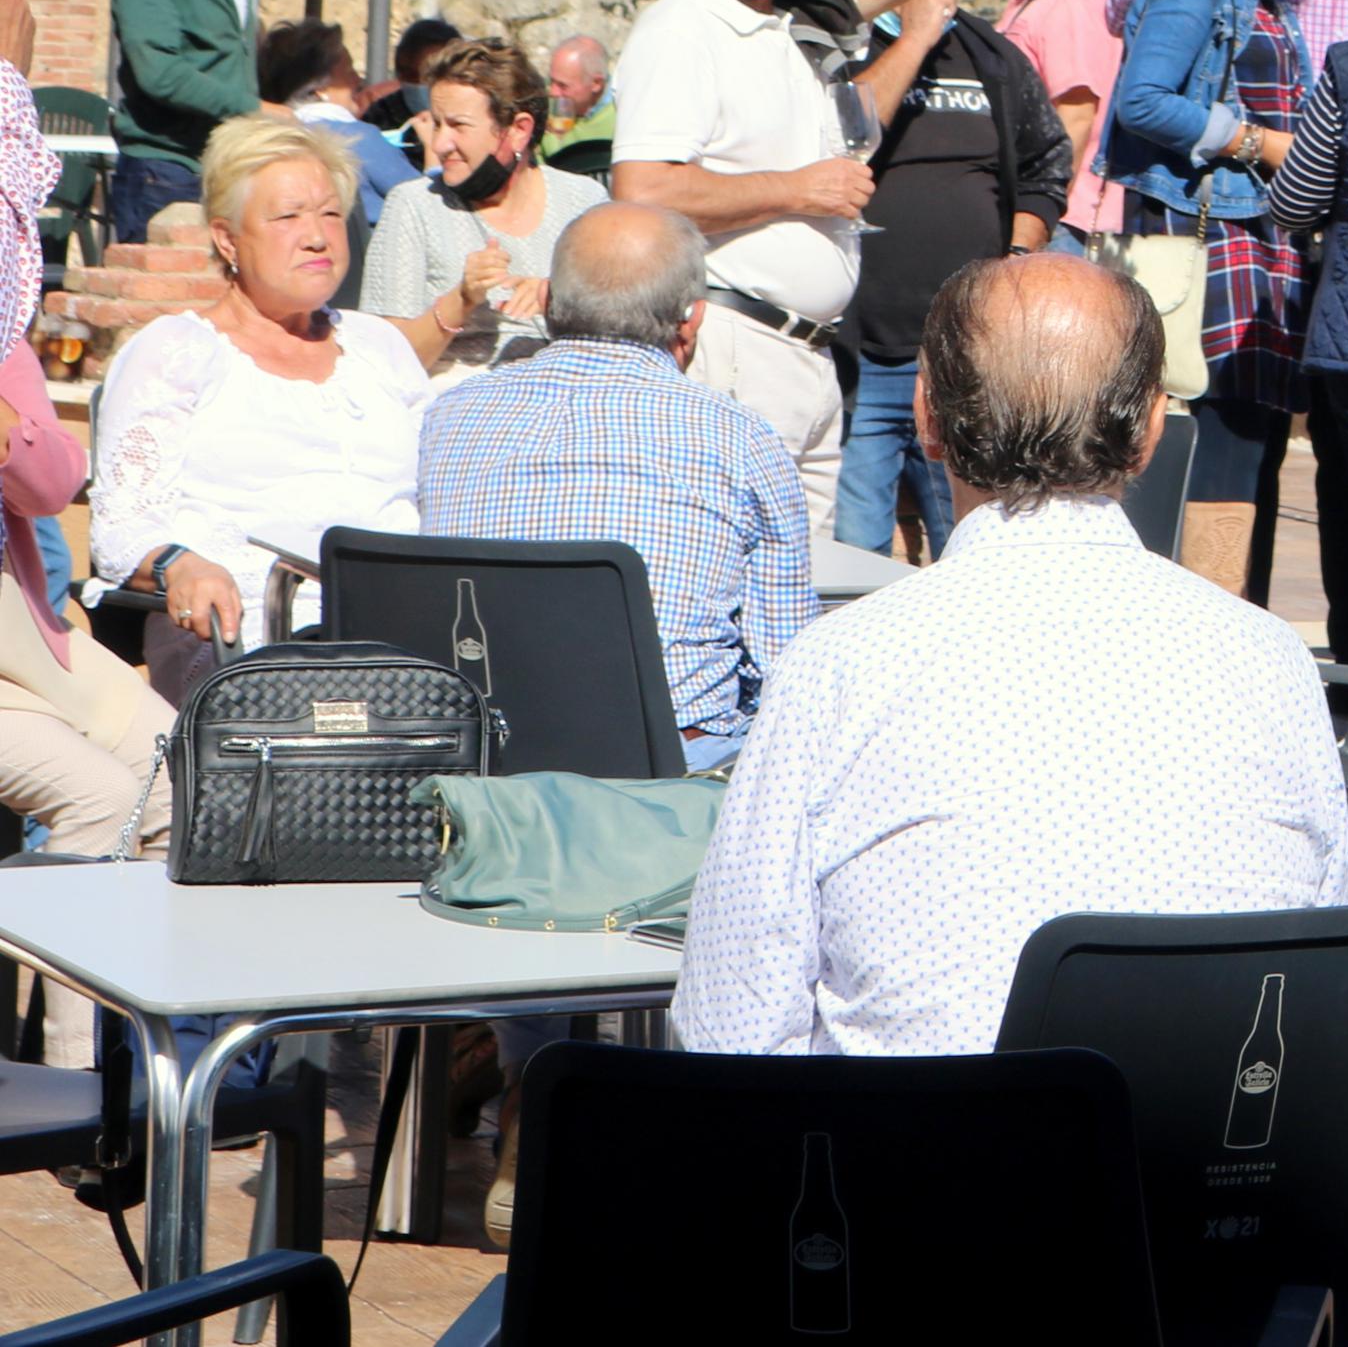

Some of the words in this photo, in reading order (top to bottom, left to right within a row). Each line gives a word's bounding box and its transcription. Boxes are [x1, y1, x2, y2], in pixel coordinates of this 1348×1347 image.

[1244, 1070, 1273, 1081] Estrella
[1206, 1161, 1277, 1174] RESISTENCIA
[1207, 1176, 1243, 1188] DESDE
